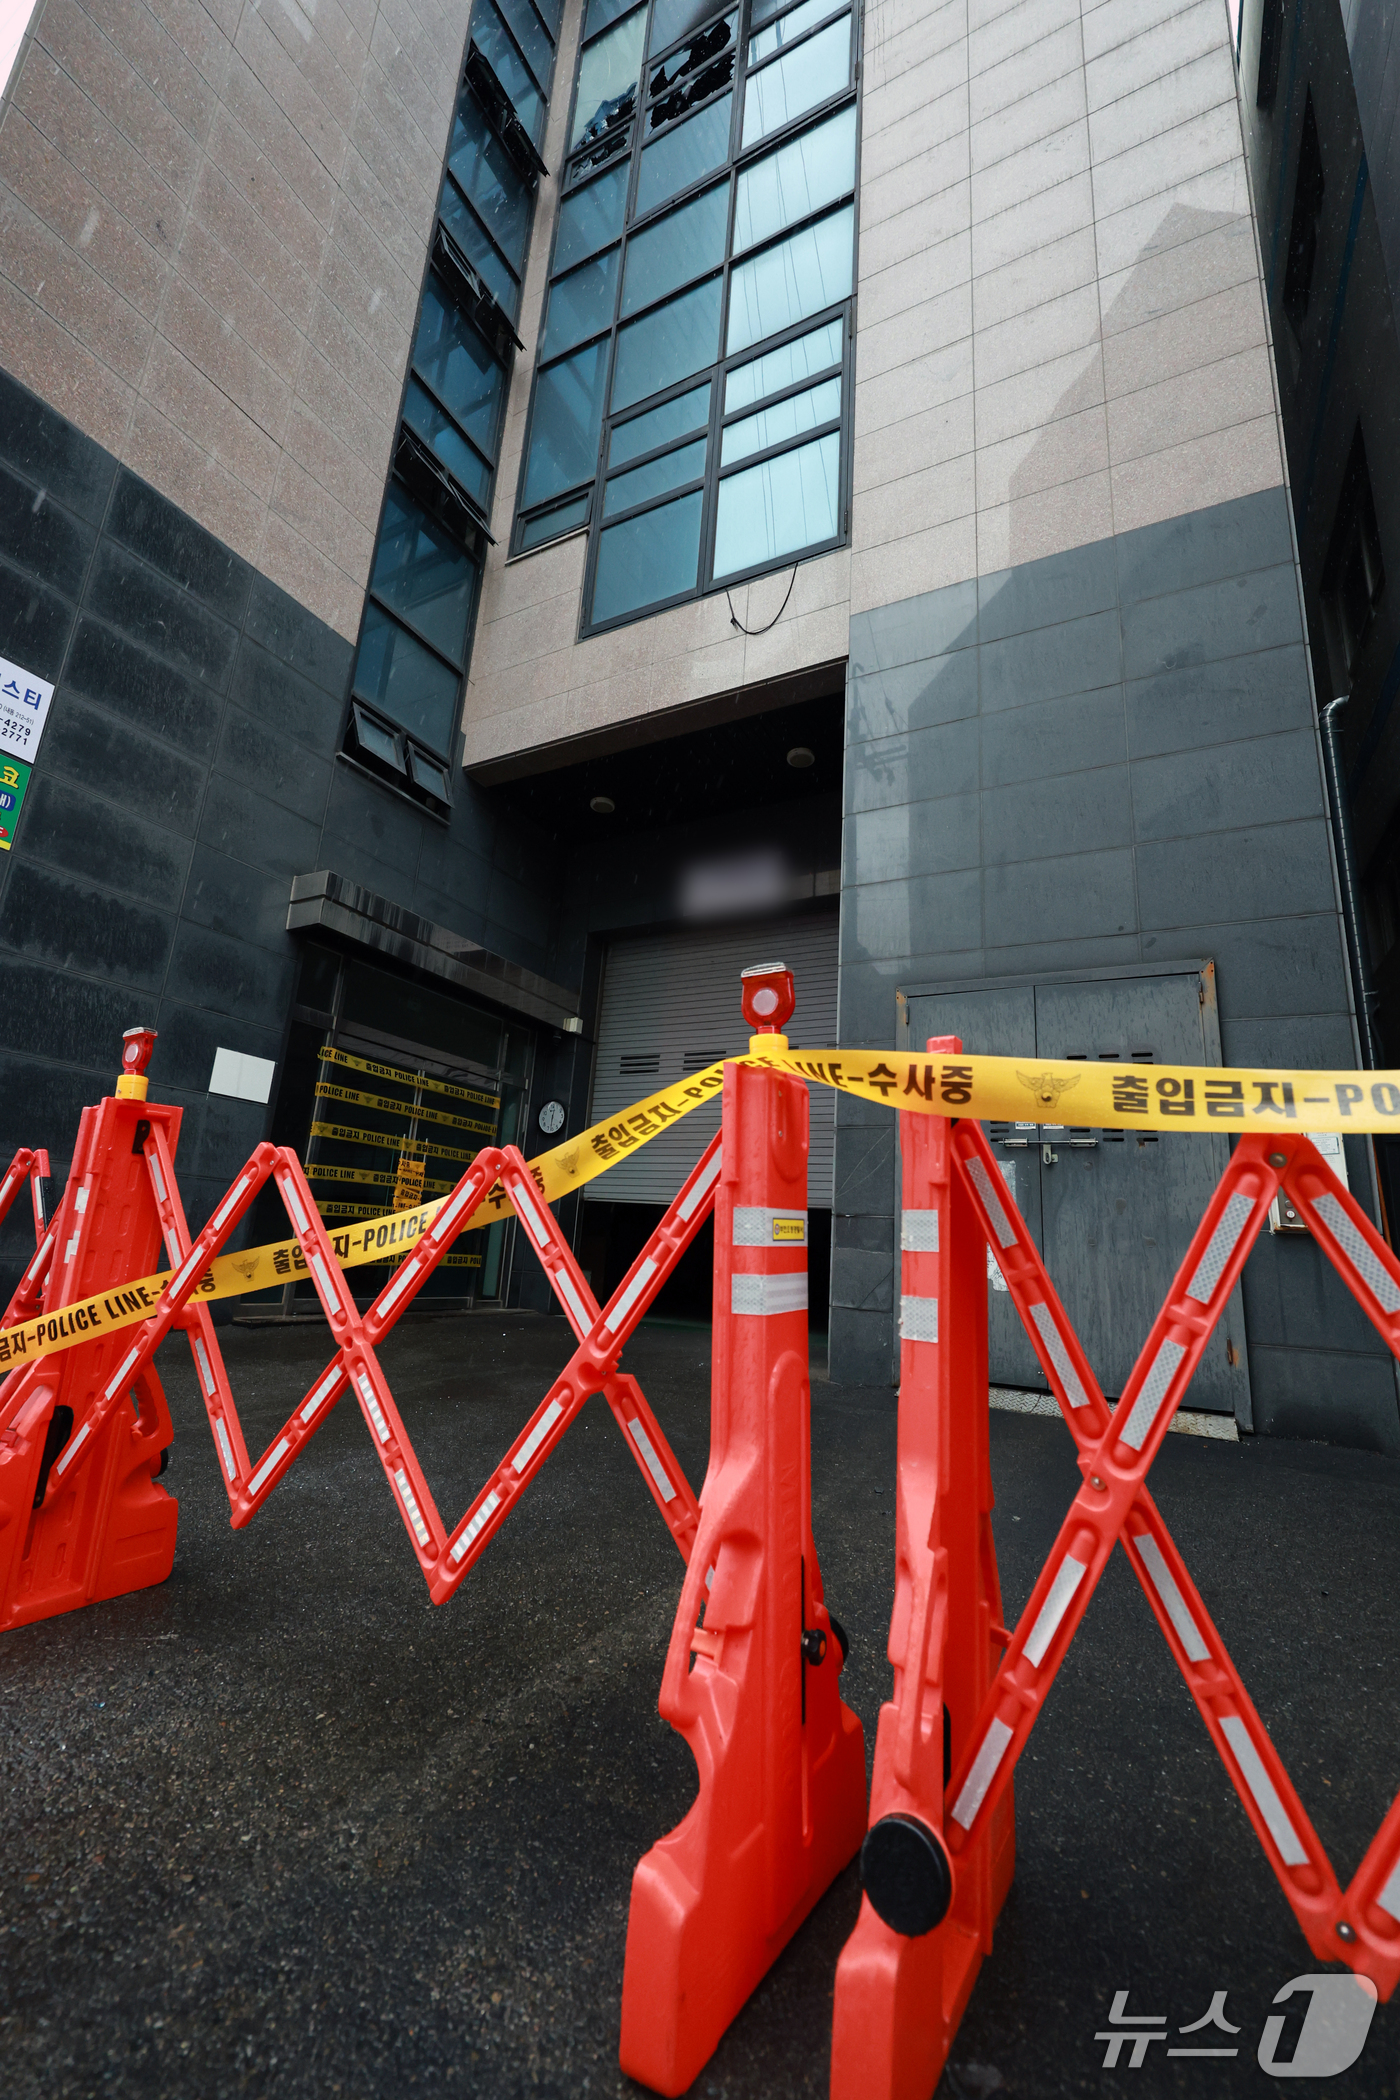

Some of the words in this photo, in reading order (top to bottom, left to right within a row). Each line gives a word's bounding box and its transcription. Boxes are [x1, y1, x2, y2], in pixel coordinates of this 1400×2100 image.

[0, 673, 42, 710] 스티
[334, 1051, 348, 1063] LINE
[394, 1070, 415, 1083] POLICE
[416, 1076, 429, 1087] LINE
[467, 1091, 484, 1102] POLICE
[319, 1085, 343, 1098] POLICE
[345, 1090, 360, 1101] LINE
[404, 1105, 424, 1116] POLICE
[425, 1108, 438, 1119] LINE
[362, 1132, 385, 1144] POLICE
[386, 1137, 400, 1147] LINE
[441, 1148, 459, 1159] POLICE
[460, 1151, 472, 1160] LINE
[312, 1167, 338, 1178] POLICE
[340, 1169, 355, 1179] LINE
[401, 1177, 422, 1188] POLICE
[423, 1181, 436, 1189] LINE
[357, 1206, 381, 1216] POLICE
[273, 1211, 428, 1274] 출입지-POLICE
